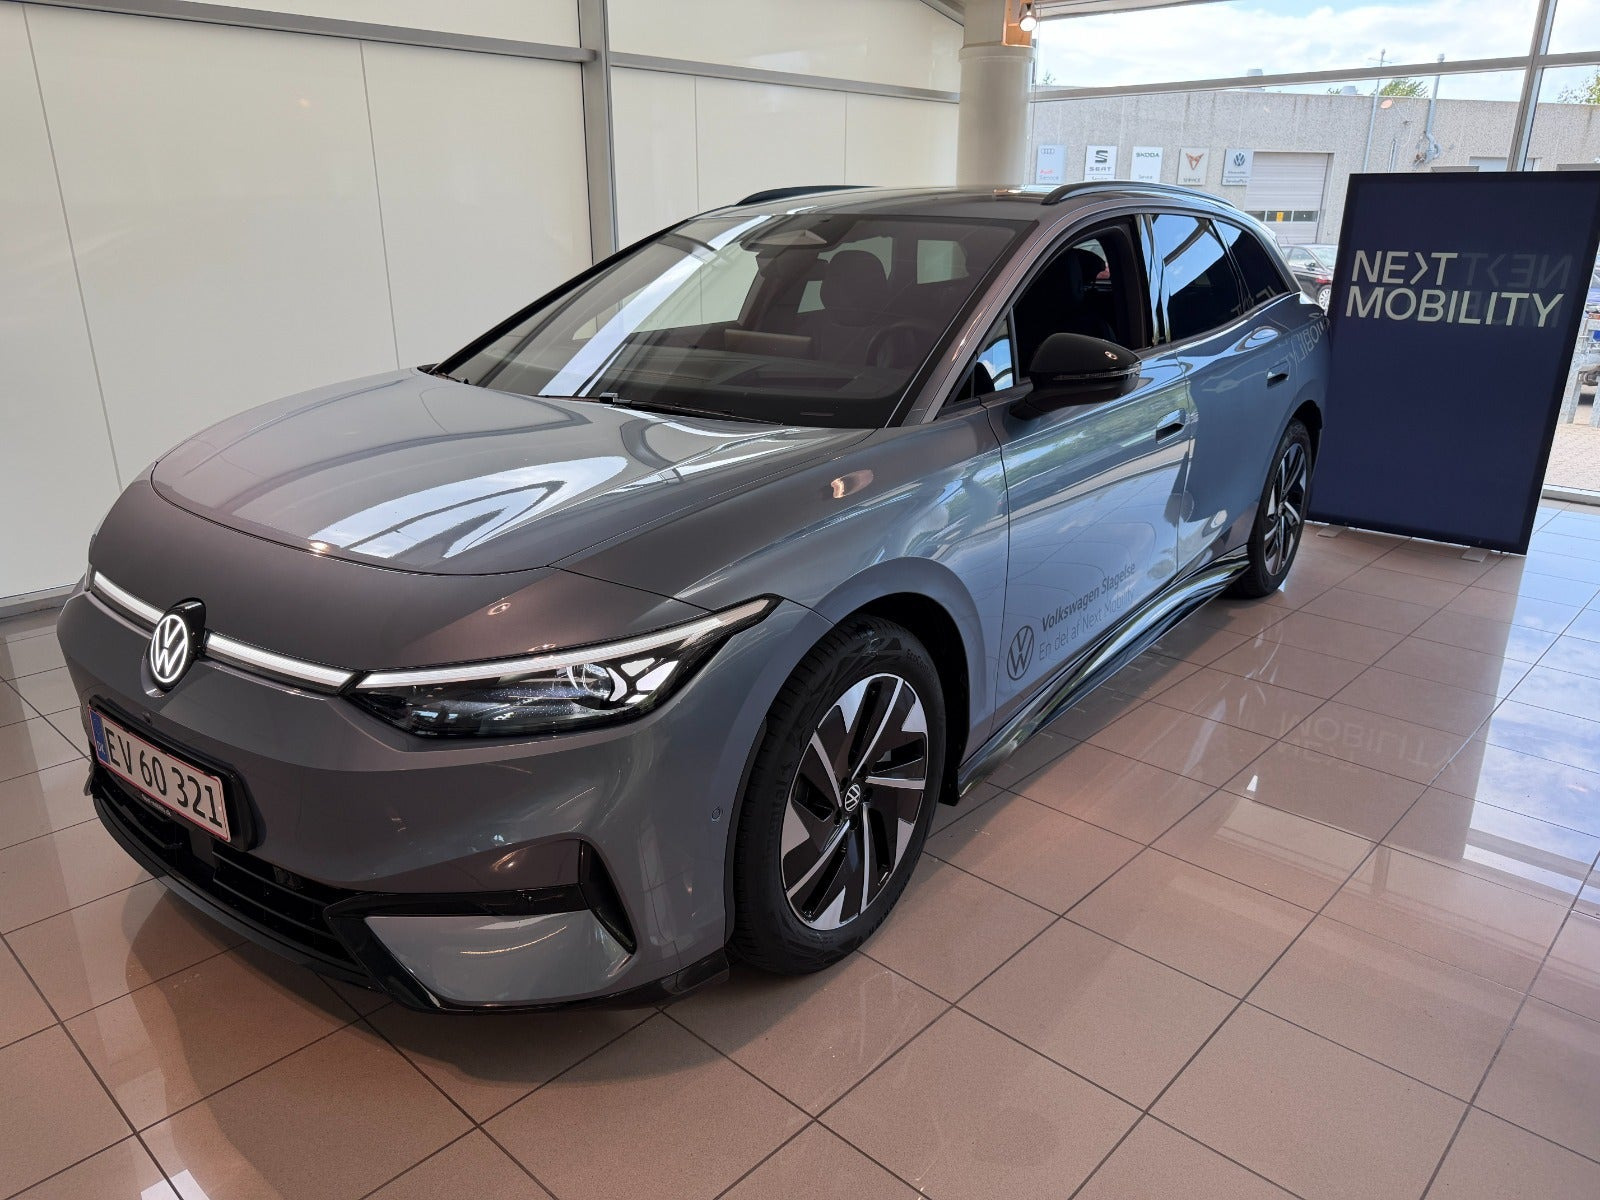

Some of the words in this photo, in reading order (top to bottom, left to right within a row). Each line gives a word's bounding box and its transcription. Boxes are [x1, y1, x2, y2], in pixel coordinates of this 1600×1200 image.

[1346, 285, 1564, 328] MOBILITY
[1042, 587, 1100, 632] Volkswagen
[1101, 563, 1136, 595] Slagelse
[1039, 642, 1052, 661] En
[1055, 627, 1069, 651] del
[1082, 608, 1103, 631] Next
[104, 726, 133, 775] EV
[140, 749, 167, 796] 60
[171, 766, 223, 829] 321
